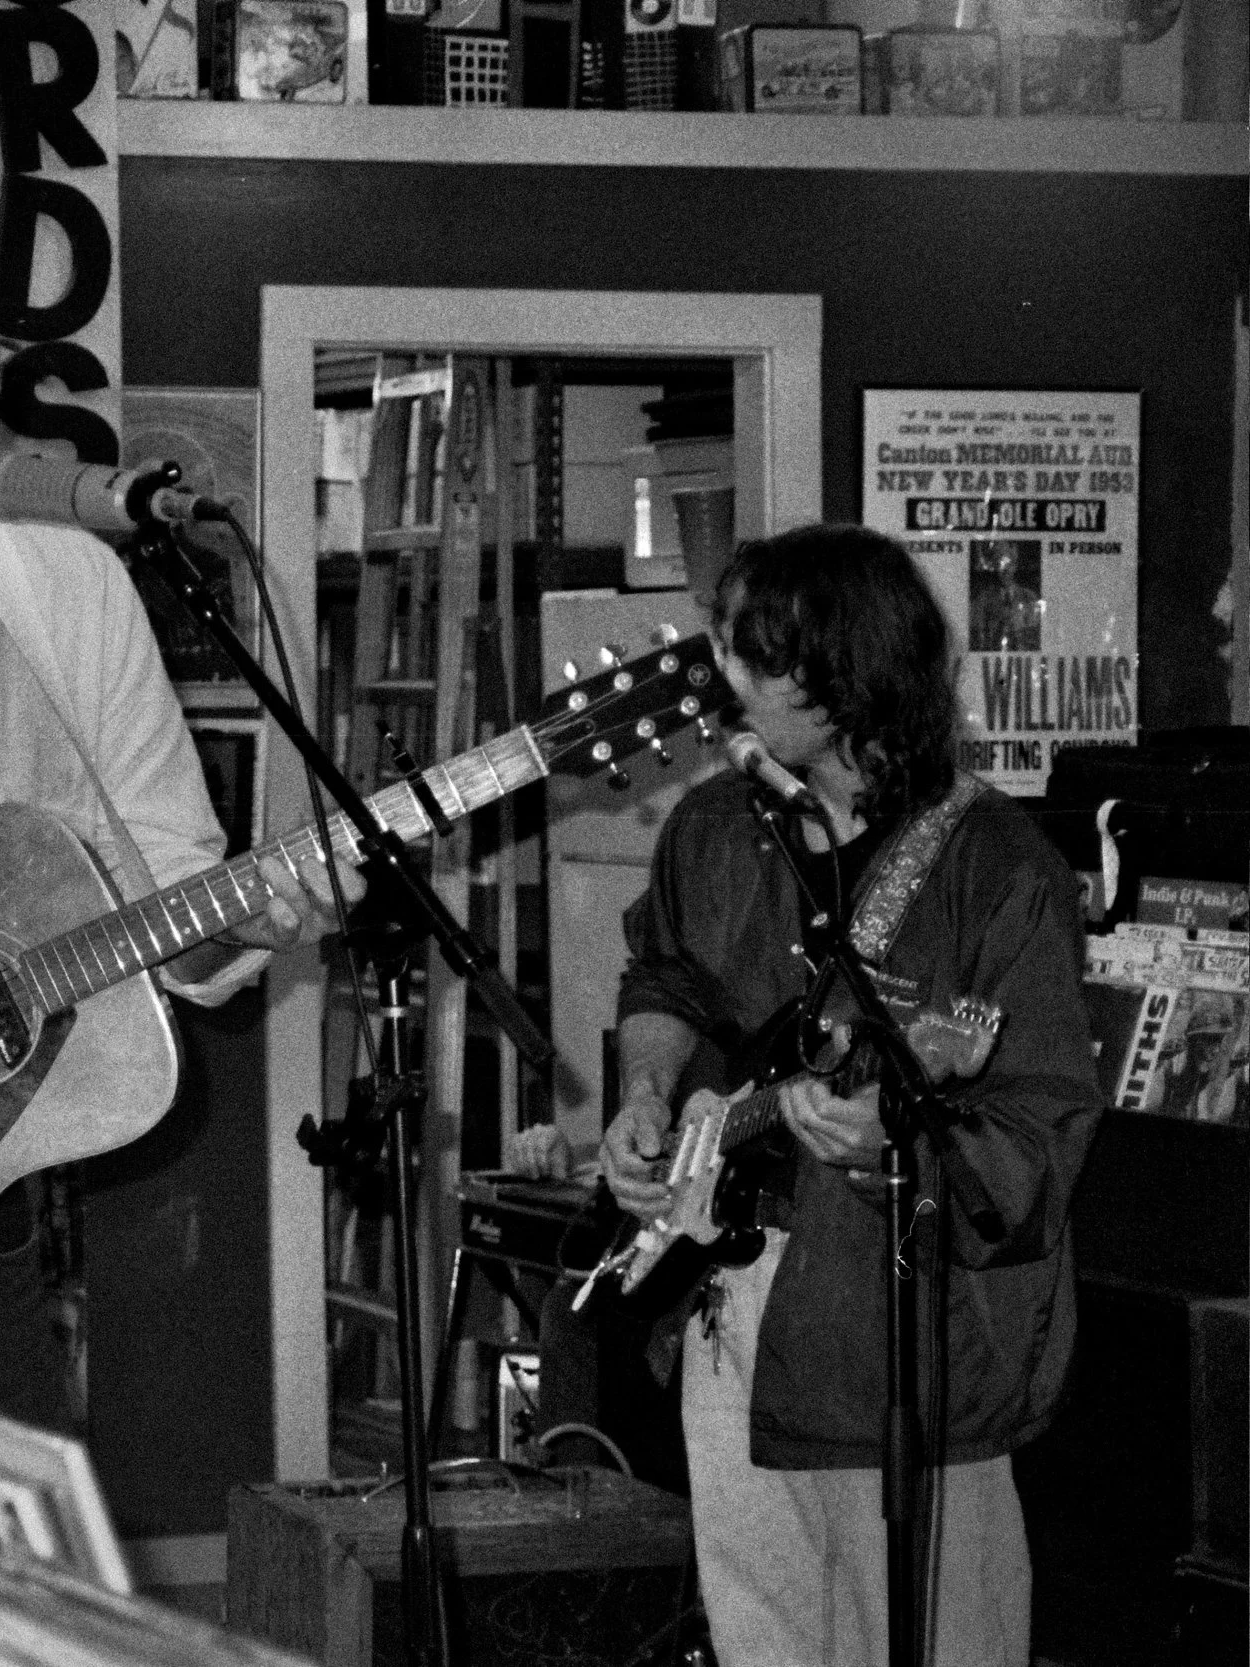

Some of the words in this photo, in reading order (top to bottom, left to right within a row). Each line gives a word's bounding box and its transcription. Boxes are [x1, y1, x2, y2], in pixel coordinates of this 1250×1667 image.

[877, 442, 951, 465] Canton
[956, 443, 1086, 466] MEMORIAL
[877, 470, 935, 492] NEW
[943, 470, 1027, 493] YEAR'S
[1035, 471, 1080, 493] DAY
[915, 501, 987, 528] GRAND
[1000, 502, 1037, 528] OLE
[1045, 503, 1100, 529] OPRY
[1049, 542, 1065, 554] IN
[1069, 542, 1122, 554] PERSON
[981, 656, 1132, 732] WILLIAMS
[1142, 884, 1178, 904] Indie
[1180, 885, 1192, 904] &
[1192, 888, 1229, 907] Punk
